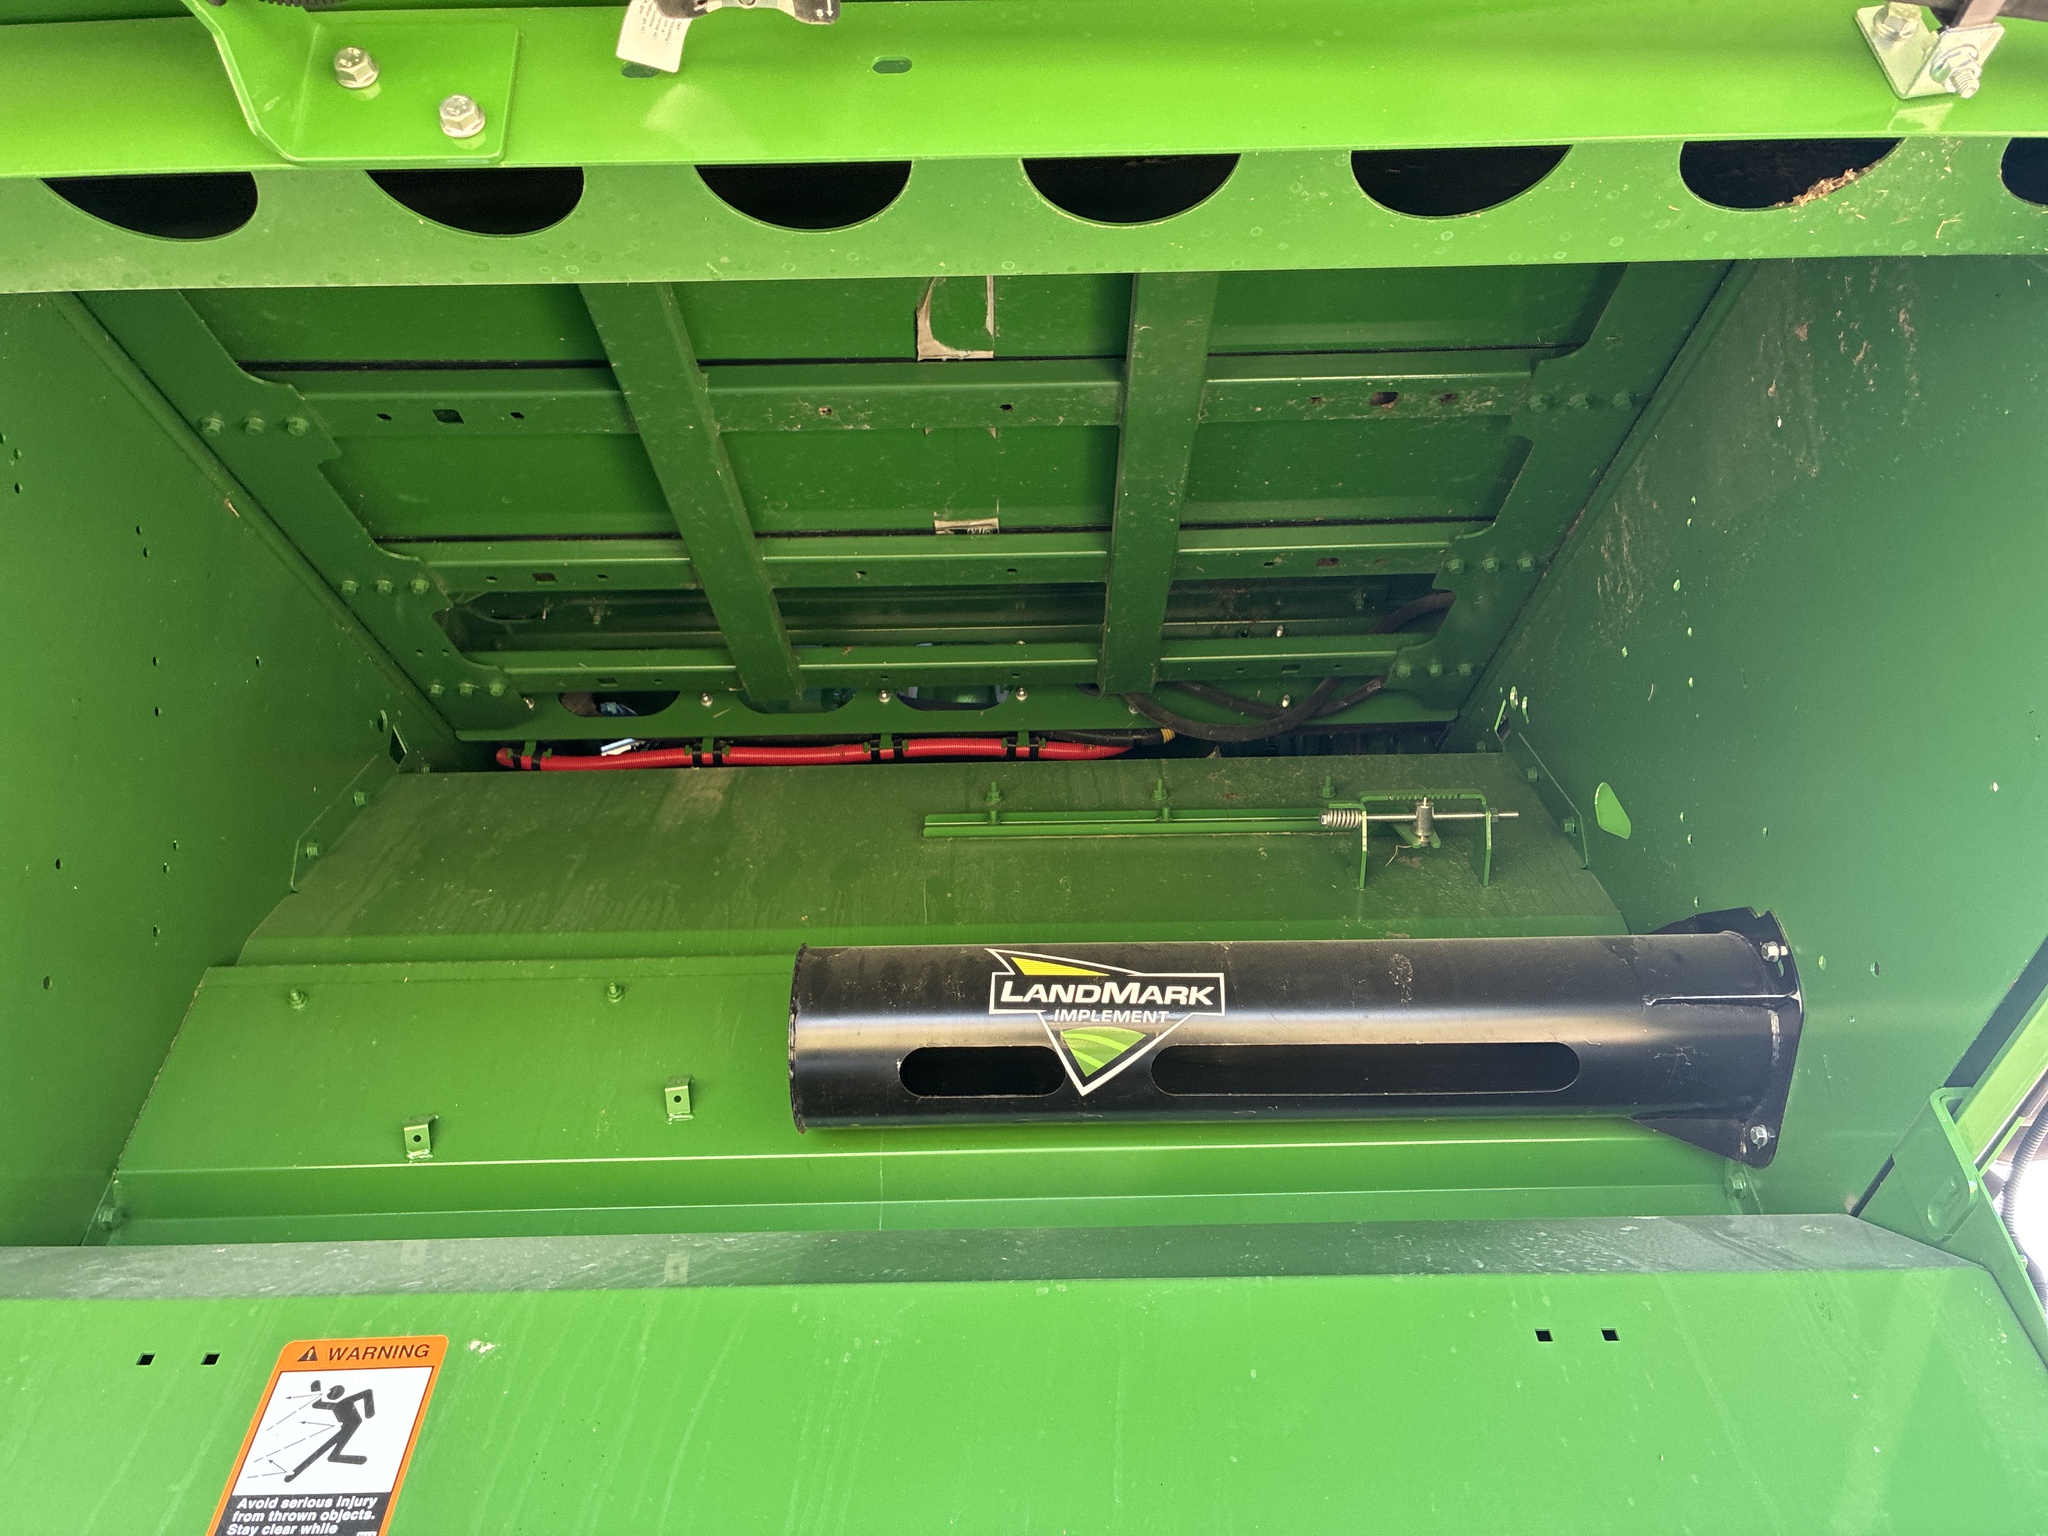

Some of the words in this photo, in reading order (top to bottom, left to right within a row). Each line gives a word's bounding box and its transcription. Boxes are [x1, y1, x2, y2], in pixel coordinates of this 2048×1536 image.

[1053, 1009, 1170, 1024] IMPLEMENT
[327, 1343, 430, 1362] WARNING
[236, 1497, 279, 1509] Avoid
[280, 1496, 333, 1509] serious
[335, 1496, 378, 1509] injury
[232, 1510, 265, 1522] from
[268, 1510, 317, 1522] thrown
[320, 1509, 376, 1523] objects.
[226, 1523, 259, 1536] Stay
[261, 1523, 297, 1535] clear
[300, 1522, 339, 1535] while
